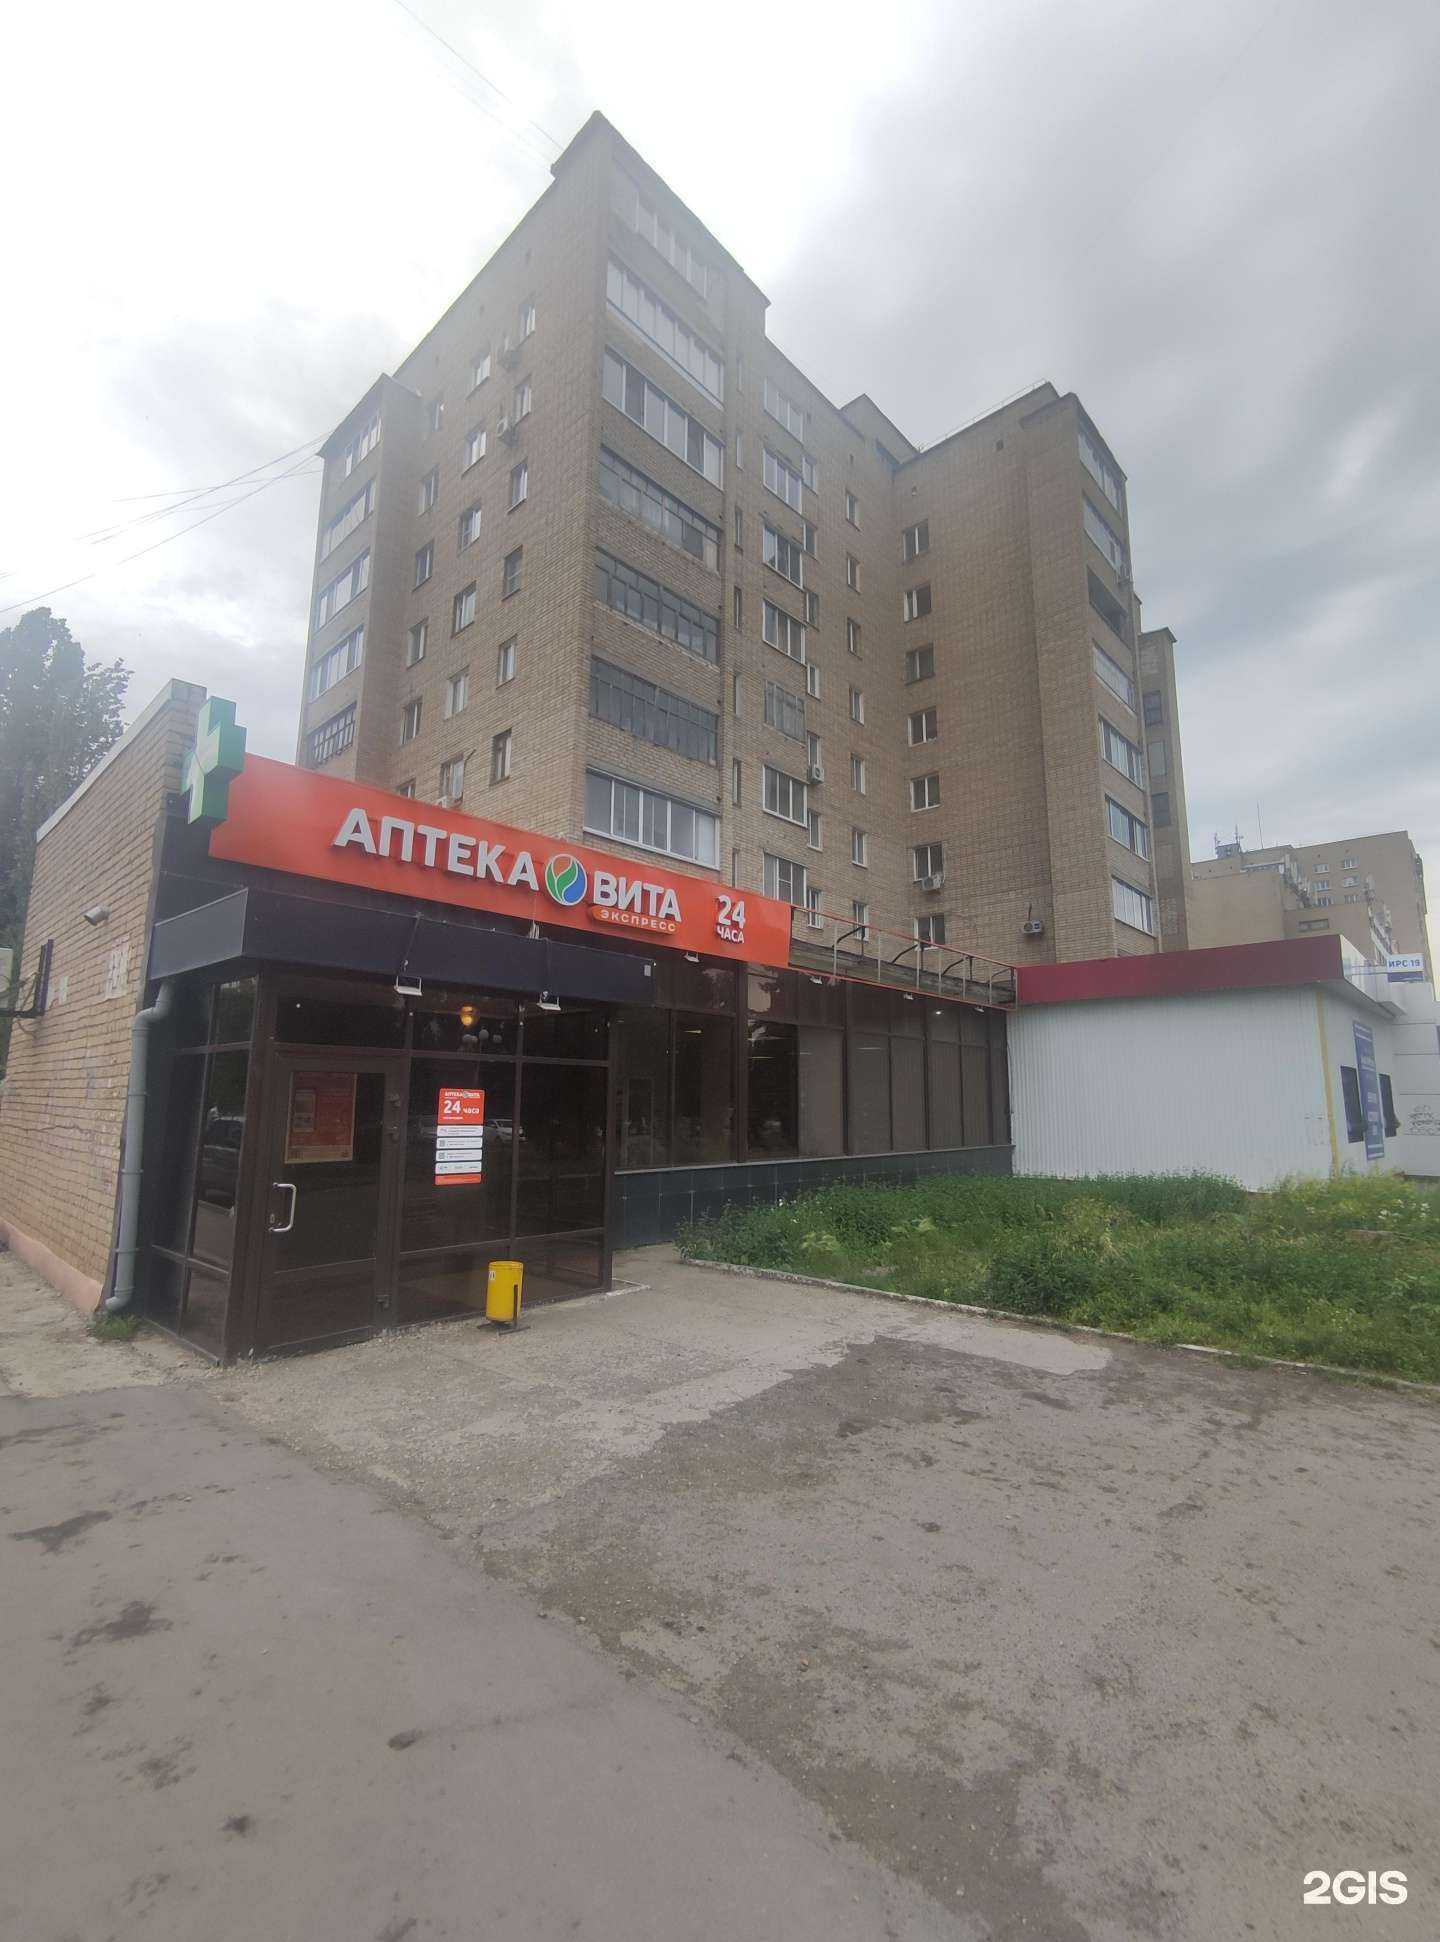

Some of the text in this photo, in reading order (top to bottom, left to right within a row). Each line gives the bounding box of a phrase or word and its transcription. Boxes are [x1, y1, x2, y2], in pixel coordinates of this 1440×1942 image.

[334, 807, 682, 922] АПТЕКА ВИТА
[600, 908, 677, 932] ЭКСПРЕСС
[718, 894, 746, 929] 24
[716, 925, 745, 944] ЧАСА
[444, 1100, 461, 1114] 24
